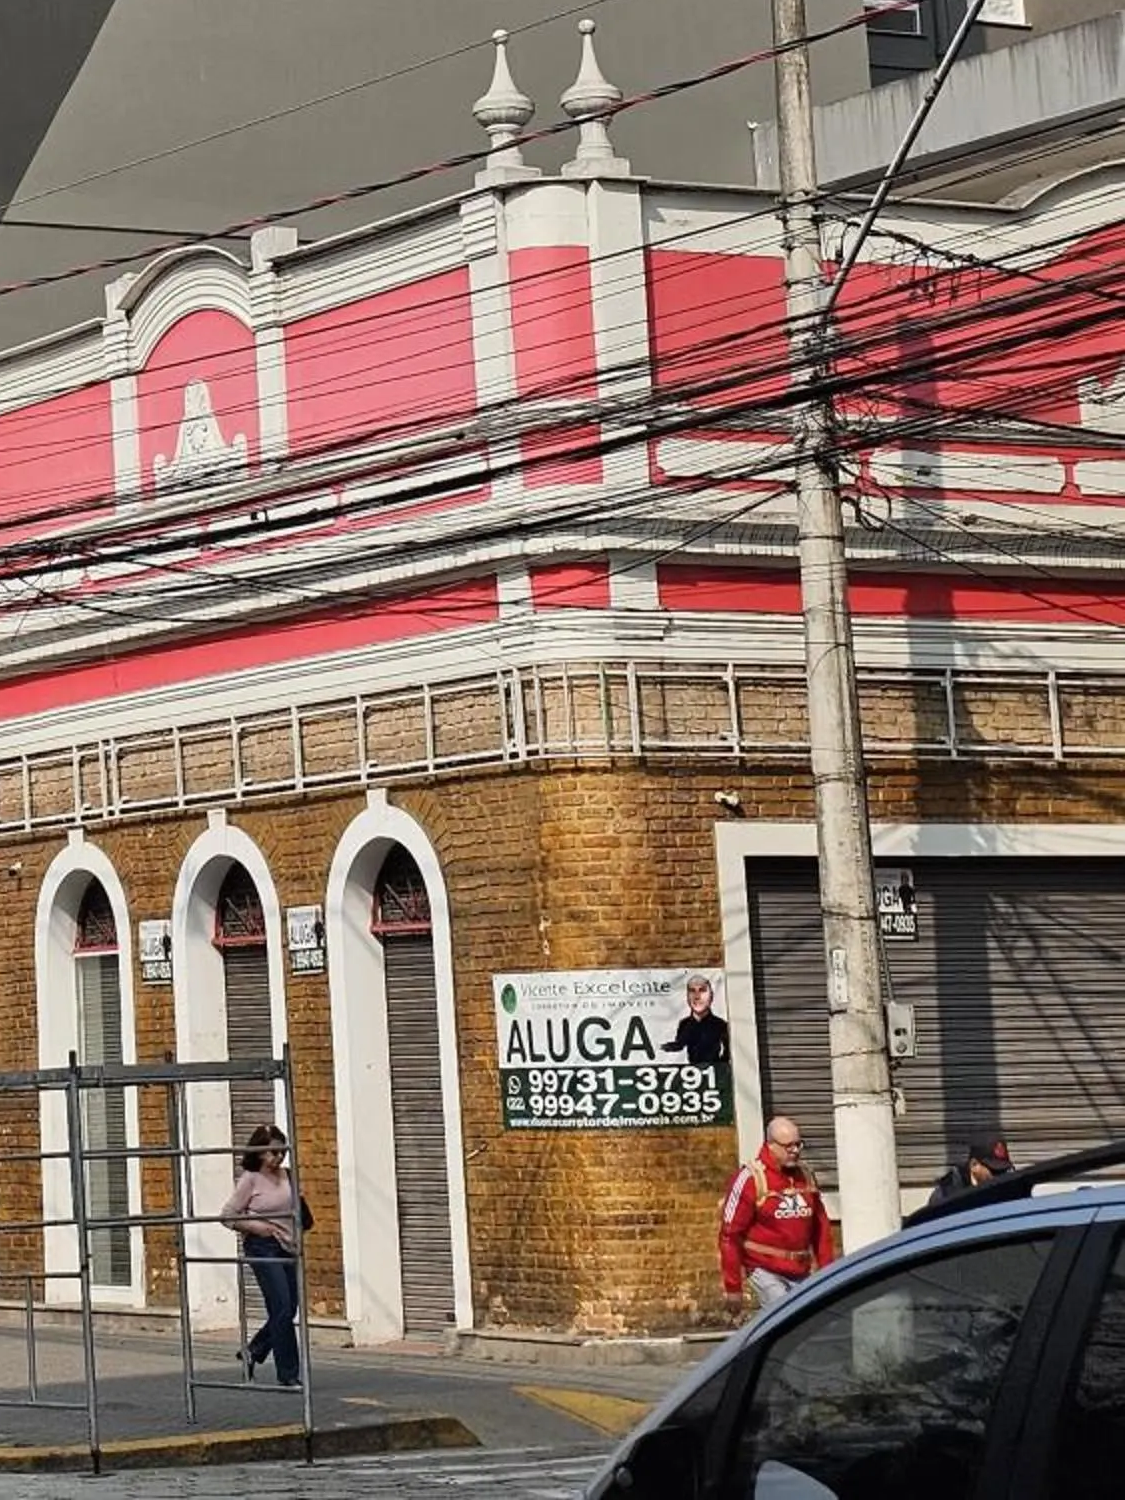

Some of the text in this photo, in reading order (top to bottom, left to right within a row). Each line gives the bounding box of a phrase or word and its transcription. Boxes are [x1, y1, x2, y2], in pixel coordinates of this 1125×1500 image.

[574, 979, 672, 996] Excelente
[506, 1015, 656, 1064] ALUGA
[528, 1066, 717, 1094] 99731-3791
[528, 1091, 722, 1116] 99947-0935
